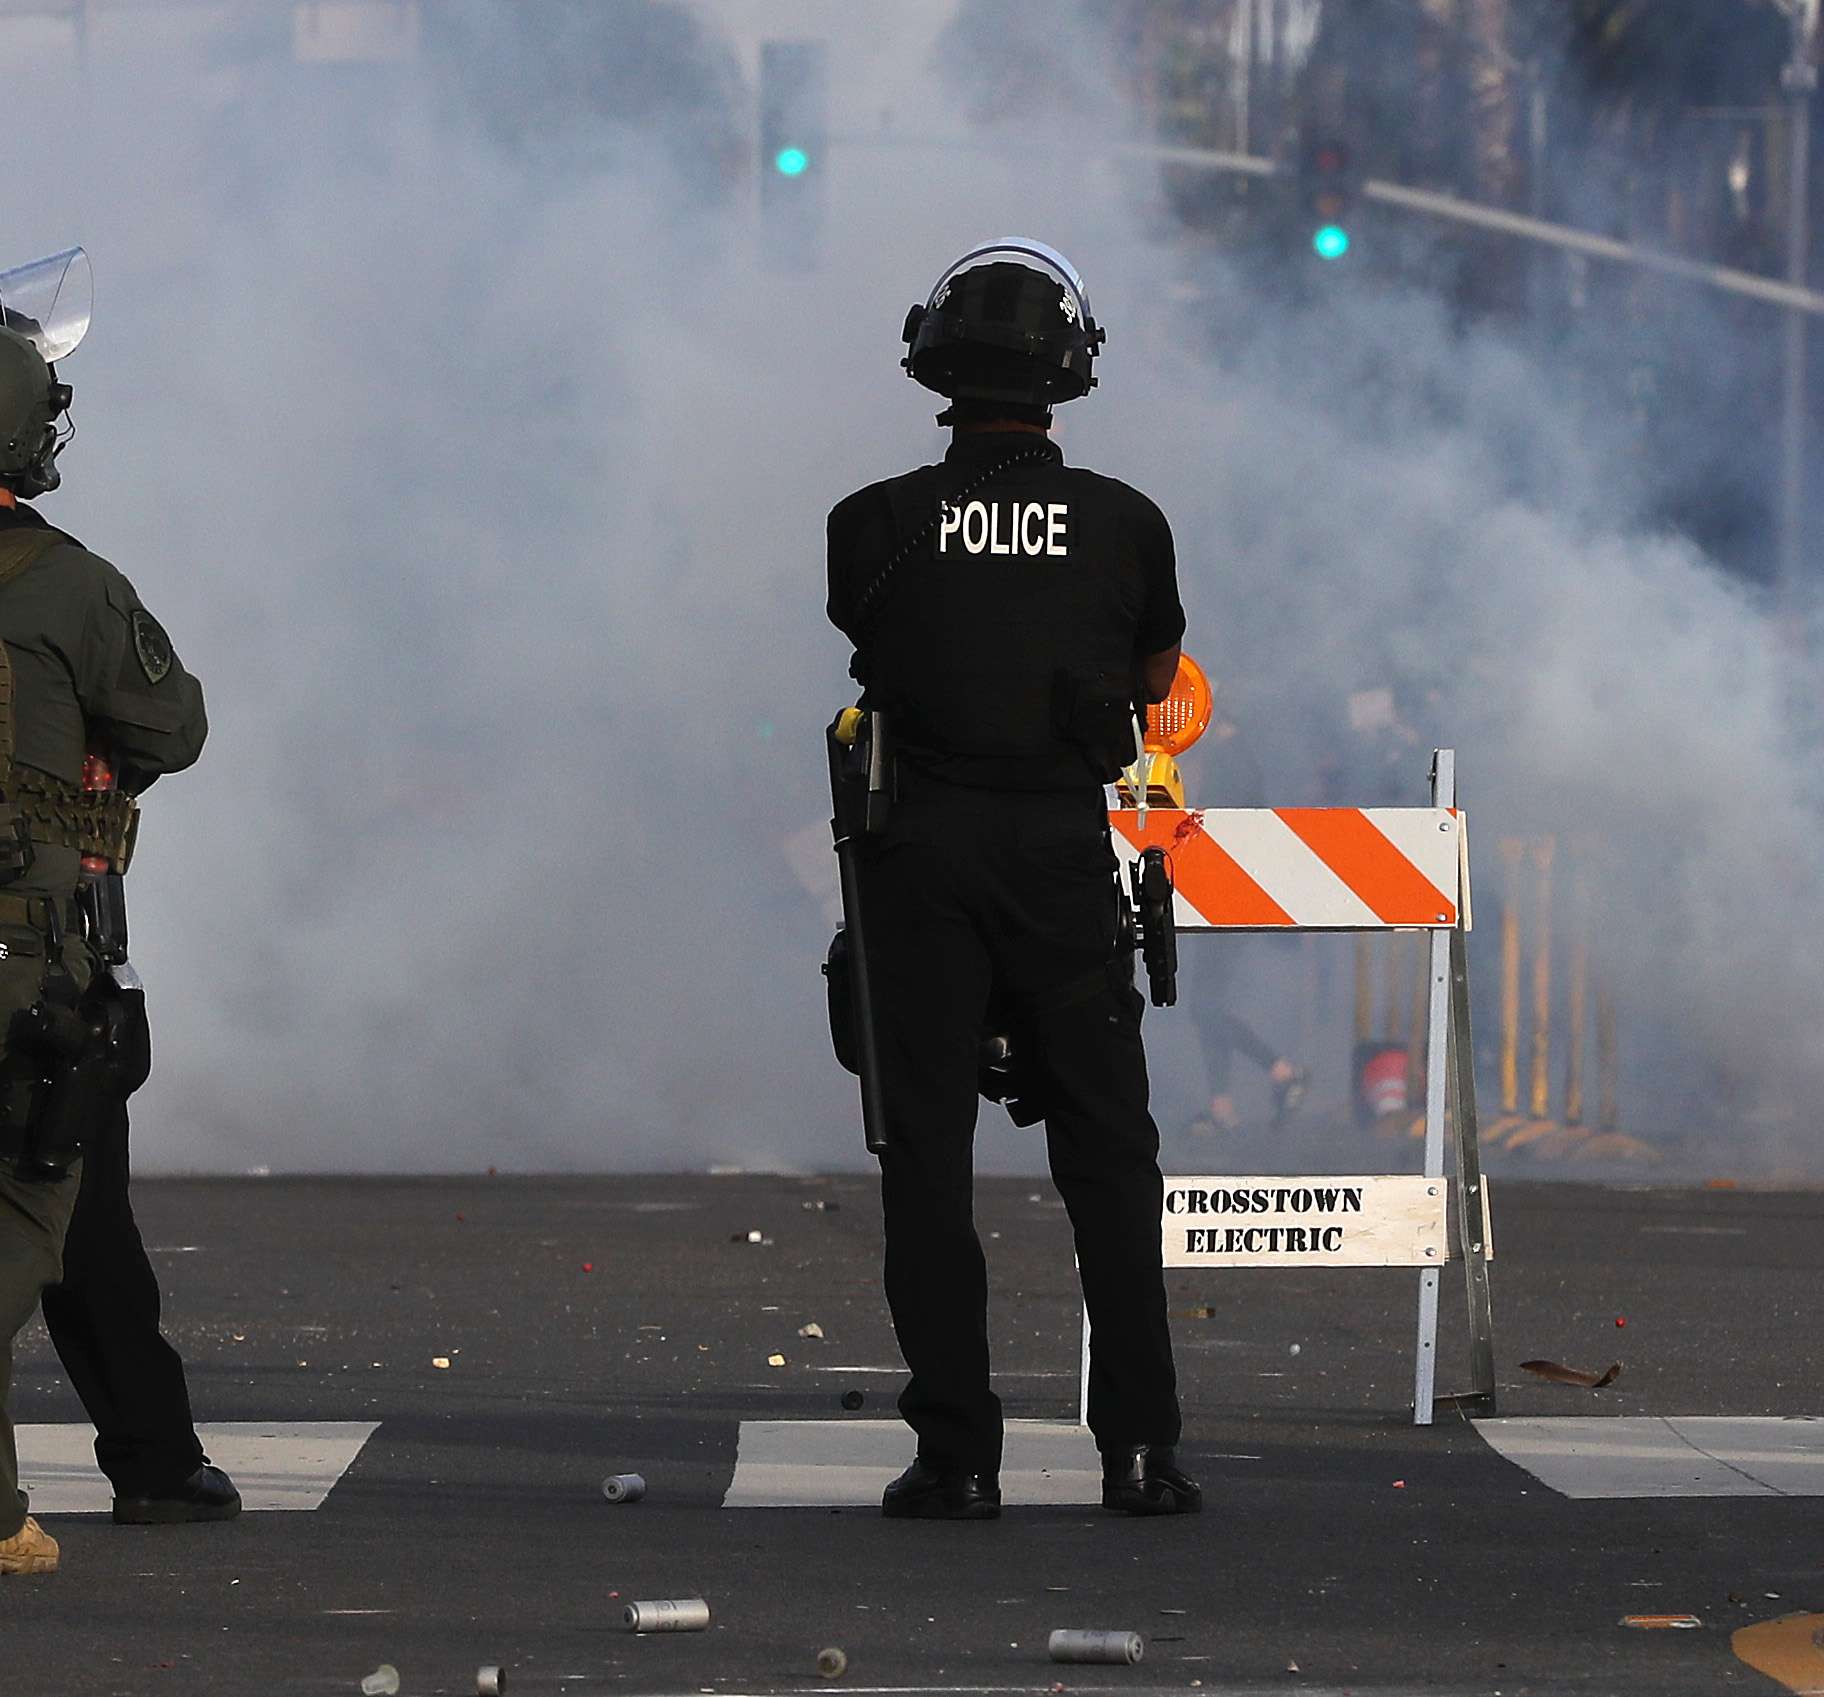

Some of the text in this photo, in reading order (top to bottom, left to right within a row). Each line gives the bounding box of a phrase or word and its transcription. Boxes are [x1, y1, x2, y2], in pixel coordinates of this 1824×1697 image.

[939, 500, 1068, 556] POLICE
[1166, 1188, 1363, 1214] CROSSTOWN
[1185, 1226, 1343, 1253] ELECTRIC
